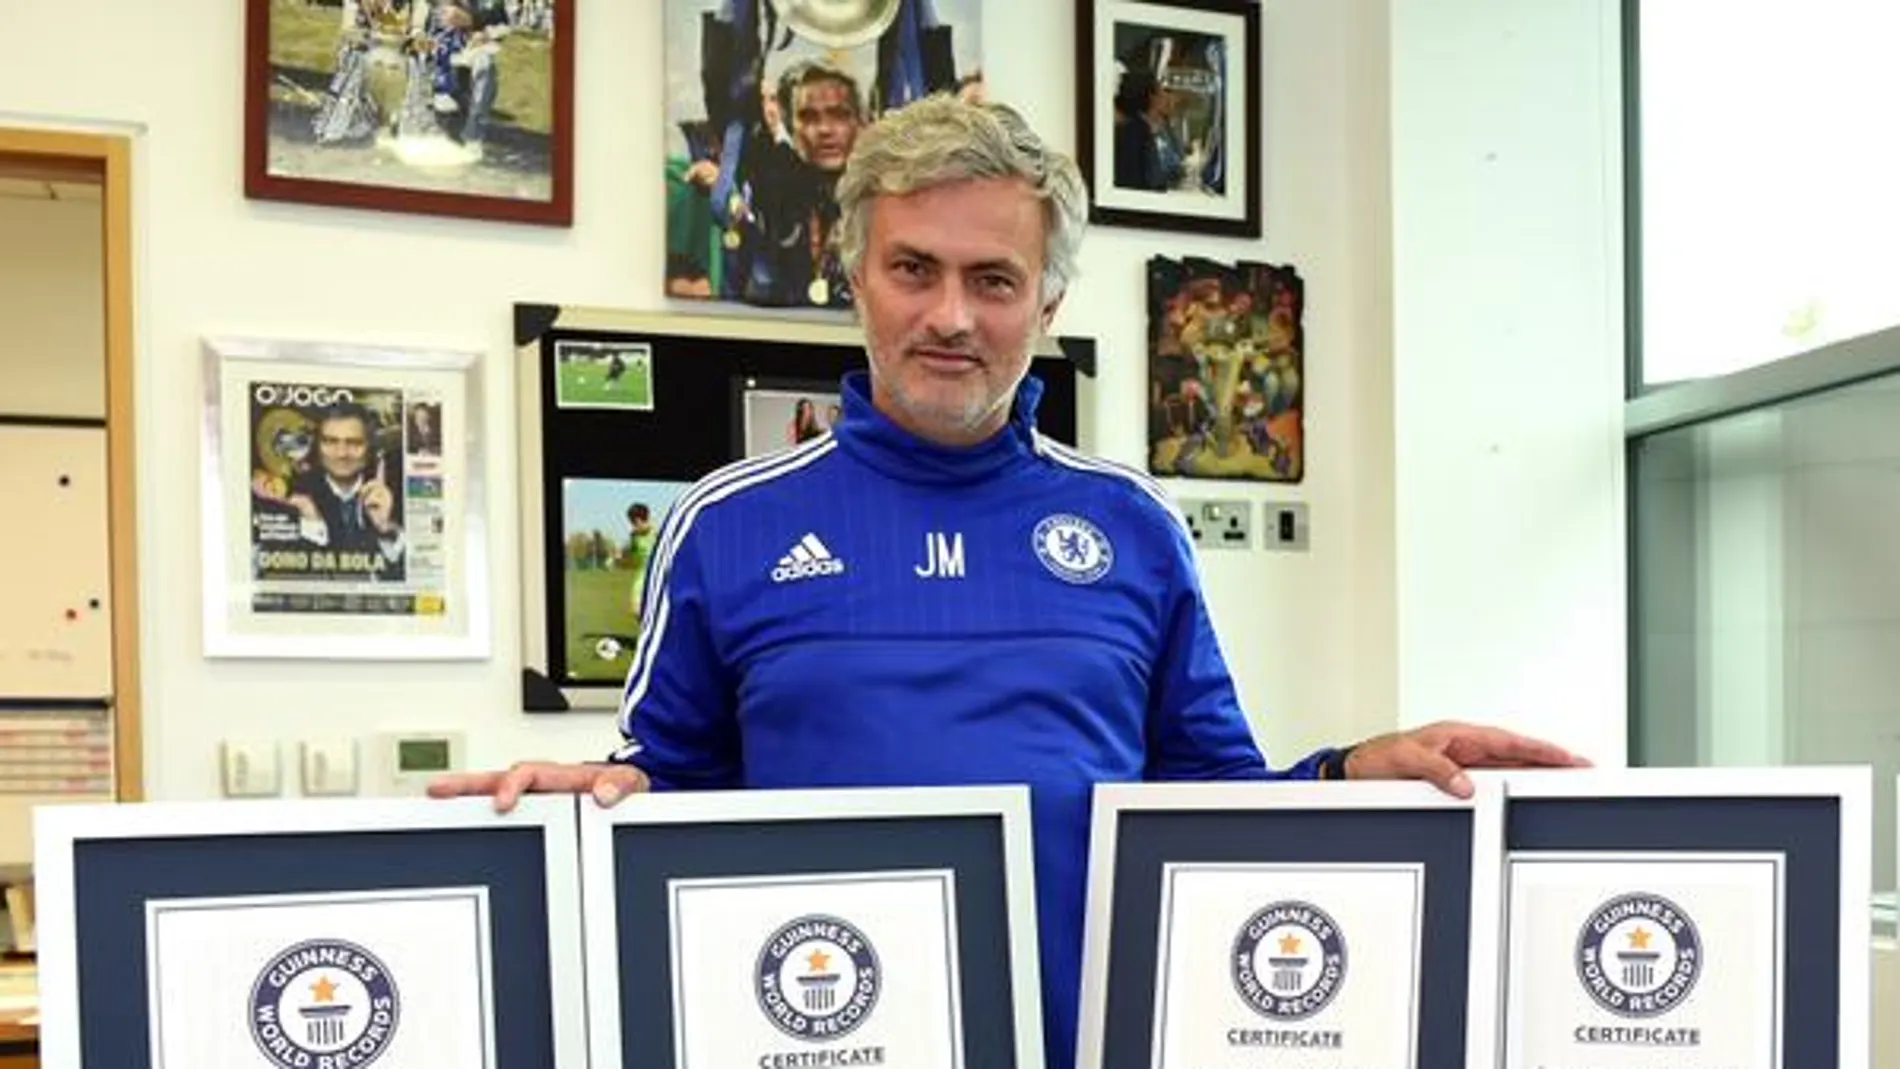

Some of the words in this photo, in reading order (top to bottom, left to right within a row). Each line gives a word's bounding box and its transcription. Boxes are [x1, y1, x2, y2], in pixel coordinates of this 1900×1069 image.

[311, 553, 336, 570] DA
[339, 553, 385, 571] BOLA
[771, 556, 844, 582] adidas
[914, 532, 965, 578] JM
[1249, 908, 1333, 940] GUINNESS
[1593, 901, 1684, 934] GUINNESS
[771, 923, 863, 958] GUINNESS
[269, 948, 378, 988] GUINNESS
[1238, 953, 1274, 1009] WORLD
[1277, 953, 1340, 1014] RECORDS
[1584, 946, 1625, 1006] WORLD
[1629, 948, 1695, 1011] RECORDS
[762, 973, 807, 1032] WORLD
[812, 967, 873, 1034] RECORDS
[257, 1004, 311, 1068] WORLD
[319, 996, 391, 1069] RECORDS
[1226, 1029, 1342, 1048] CERTIFICATE
[1573, 1026, 1700, 1045] CERTIFICATE
[758, 1046, 886, 1069] CERTIFICATE
